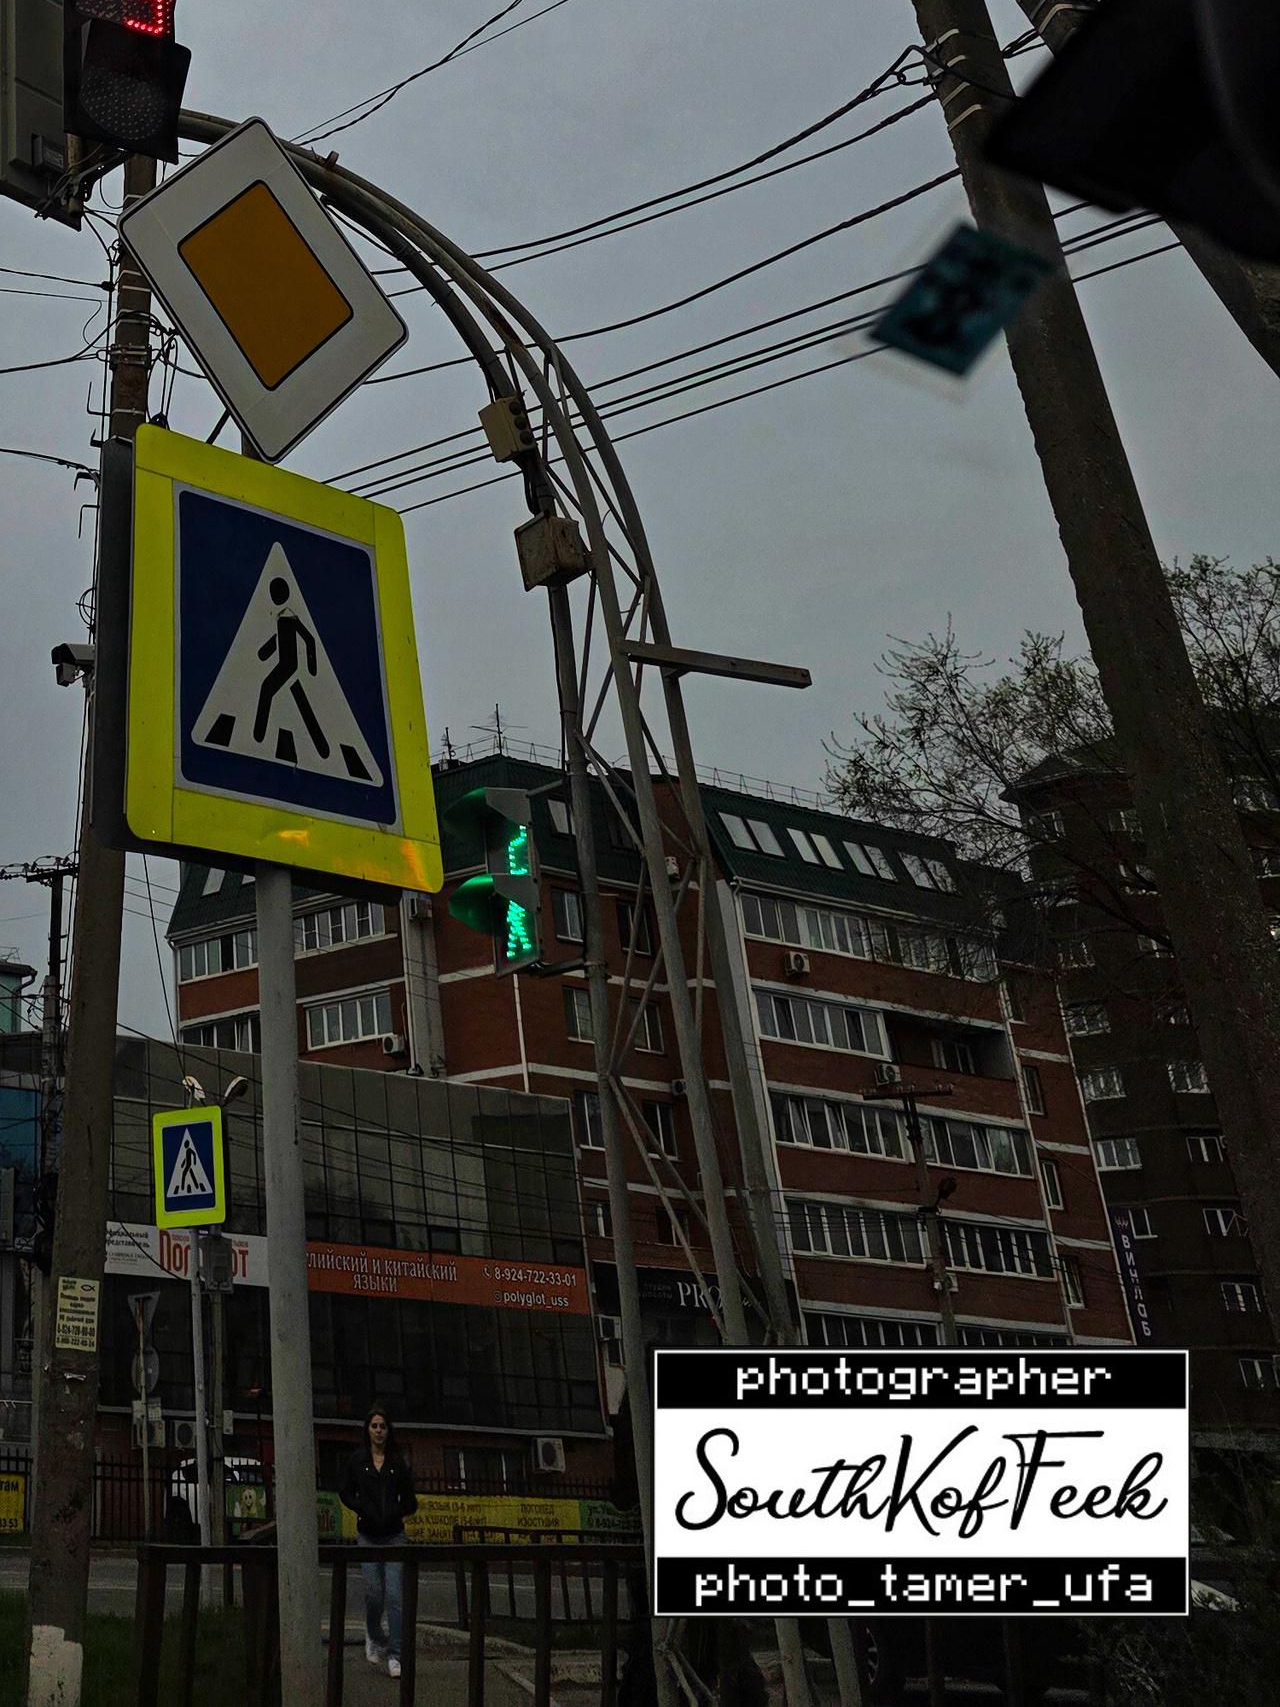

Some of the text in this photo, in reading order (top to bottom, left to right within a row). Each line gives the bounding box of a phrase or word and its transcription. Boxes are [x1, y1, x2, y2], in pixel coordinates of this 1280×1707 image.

[372, 1261, 381, 1274] и
[385, 1256, 457, 1282] китайский
[494, 1266, 577, 1287] 8-924-722-33-01
[503, 1290, 569, 1308] polyglot_uss
[8, 1518, 18, 1528] 53
